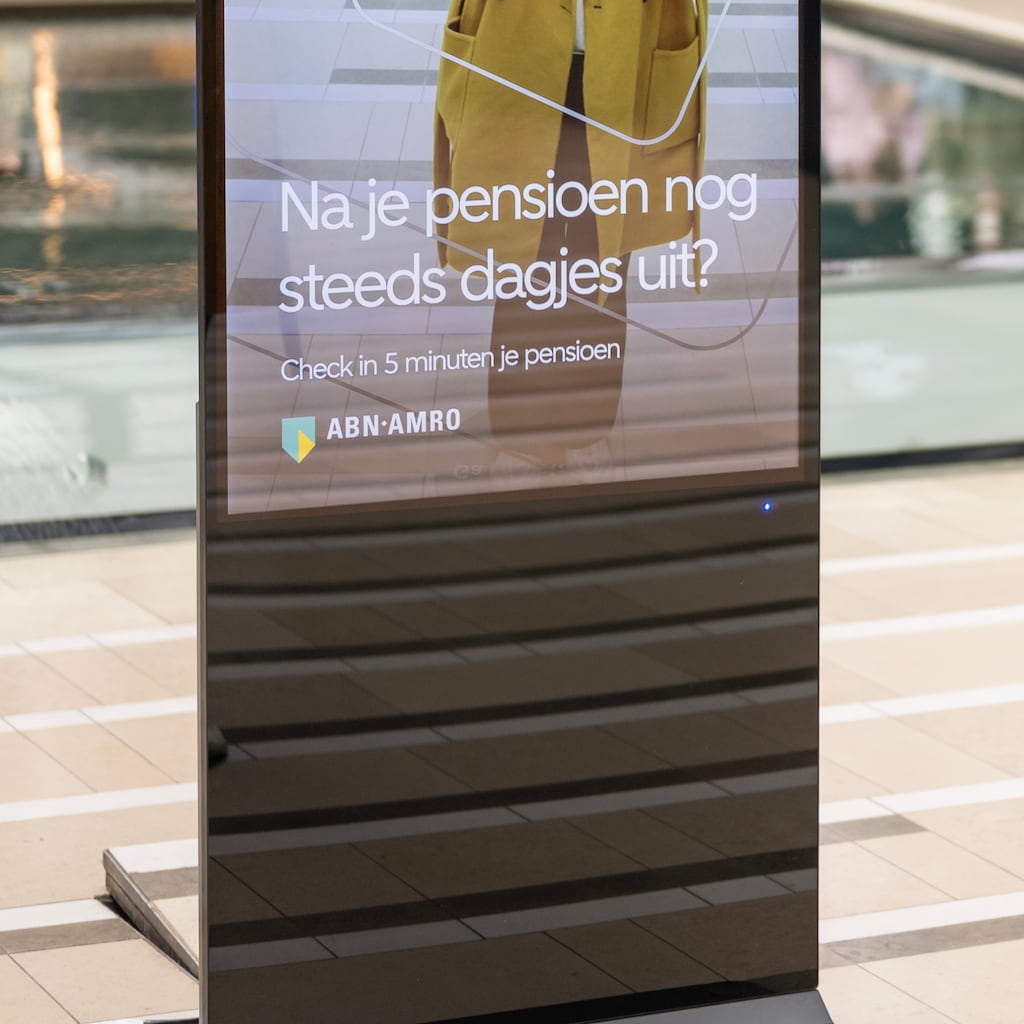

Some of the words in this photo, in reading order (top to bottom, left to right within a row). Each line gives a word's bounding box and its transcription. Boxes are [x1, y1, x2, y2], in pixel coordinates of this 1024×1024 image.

[281, 180, 354, 232] Na
[361, 177, 410, 241] je
[426, 169, 649, 238] pensioen
[665, 173, 757, 221] nog
[278, 253, 447, 313] steeds
[461, 247, 623, 311] dagjes
[638, 238, 719, 291] uit?
[280, 354, 354, 381] Check
[358, 354, 378, 376] in
[384, 352, 399, 374] 5
[405, 348, 495, 373] minuten
[498, 345, 519, 372] je
[525, 339, 621, 370] pensioen
